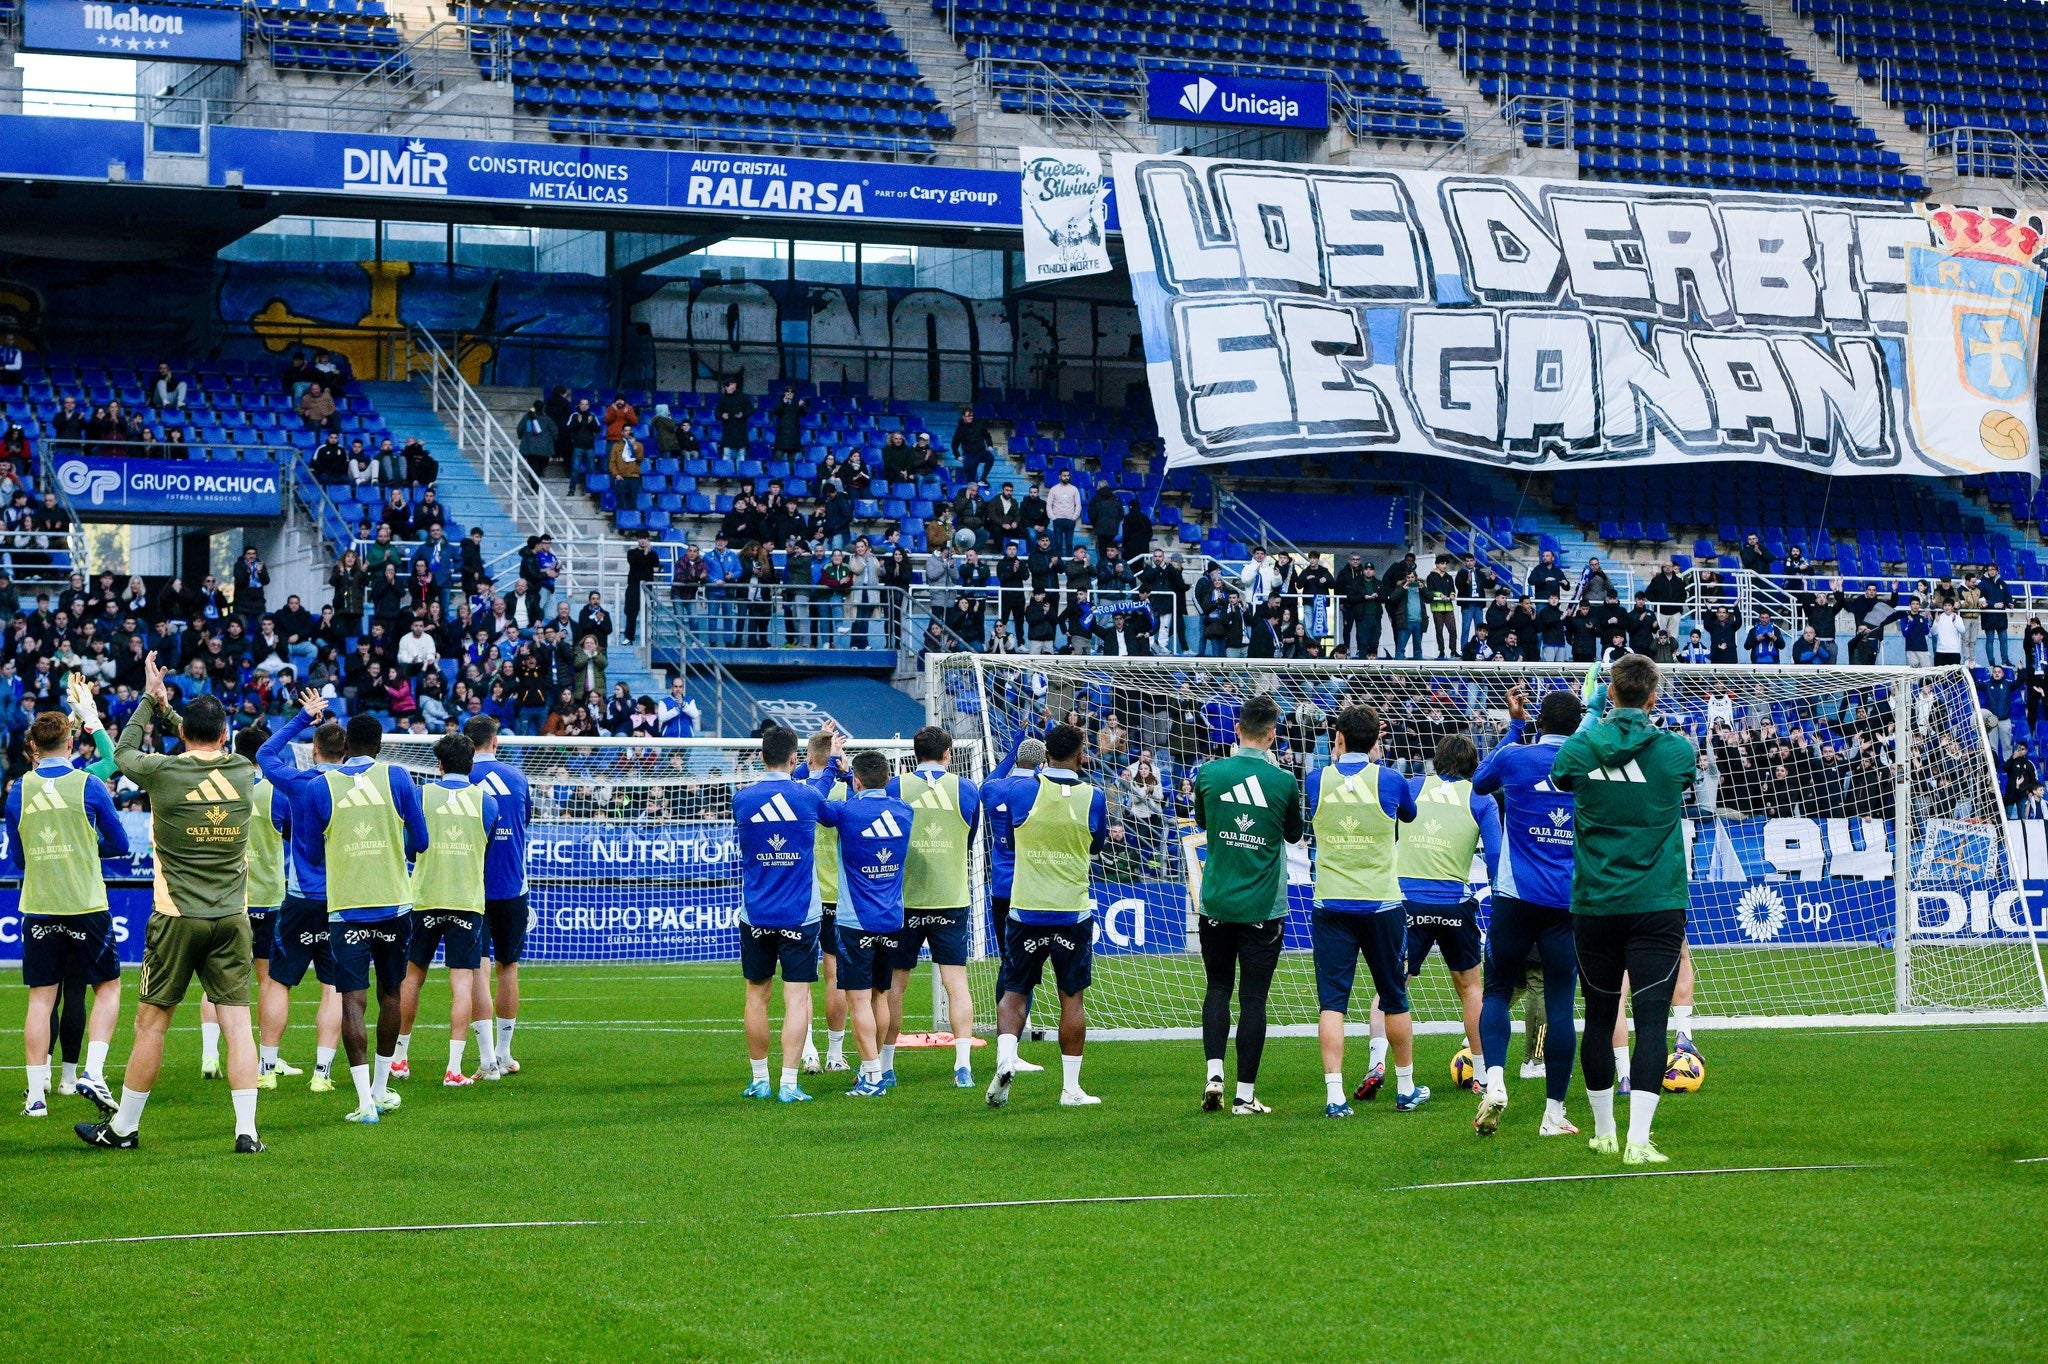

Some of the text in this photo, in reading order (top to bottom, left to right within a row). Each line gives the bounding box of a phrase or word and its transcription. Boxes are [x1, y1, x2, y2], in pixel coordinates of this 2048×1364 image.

[82, 4, 184, 35] Mahou
[1221, 91, 1299, 121] Unicaja
[468, 155, 629, 181] CONSTRUCCIONES
[691, 159, 788, 176] AUTO CRISTAL
[529, 181, 629, 203] METÁLICAS
[687, 175, 864, 213] RALARSA
[875, 189, 895, 198] PART
[909, 186, 948, 204] Cary
[950, 188, 998, 206] group
[1136, 159, 1431, 303] LOS
[1038, 259, 1100, 274] FONDO NORTE
[1171, 295, 1401, 457] SE
[1398, 305, 1900, 467] GANAN
[131, 473, 190, 491] GRUPO
[193, 475, 276, 494] PACHUCA
[186, 827, 241, 835] CAJA RURAL
[1219, 831, 1266, 846] CAJA RURAL
[1529, 827, 1552, 836] CAJA
[360, 840, 388, 850] RURAL
[1326, 836, 1376, 844] CAJA RURAL
[1426, 836, 1452, 848] RURAL
[46, 844, 74, 854] RURAL
[1048, 852, 1074, 860] RURAL
[880, 864, 900, 872] RURAL
[555, 906, 642, 931] GRUPO
[1798, 895, 1831, 929] bp
[1416, 915, 1462, 927] DEXTOOLS
